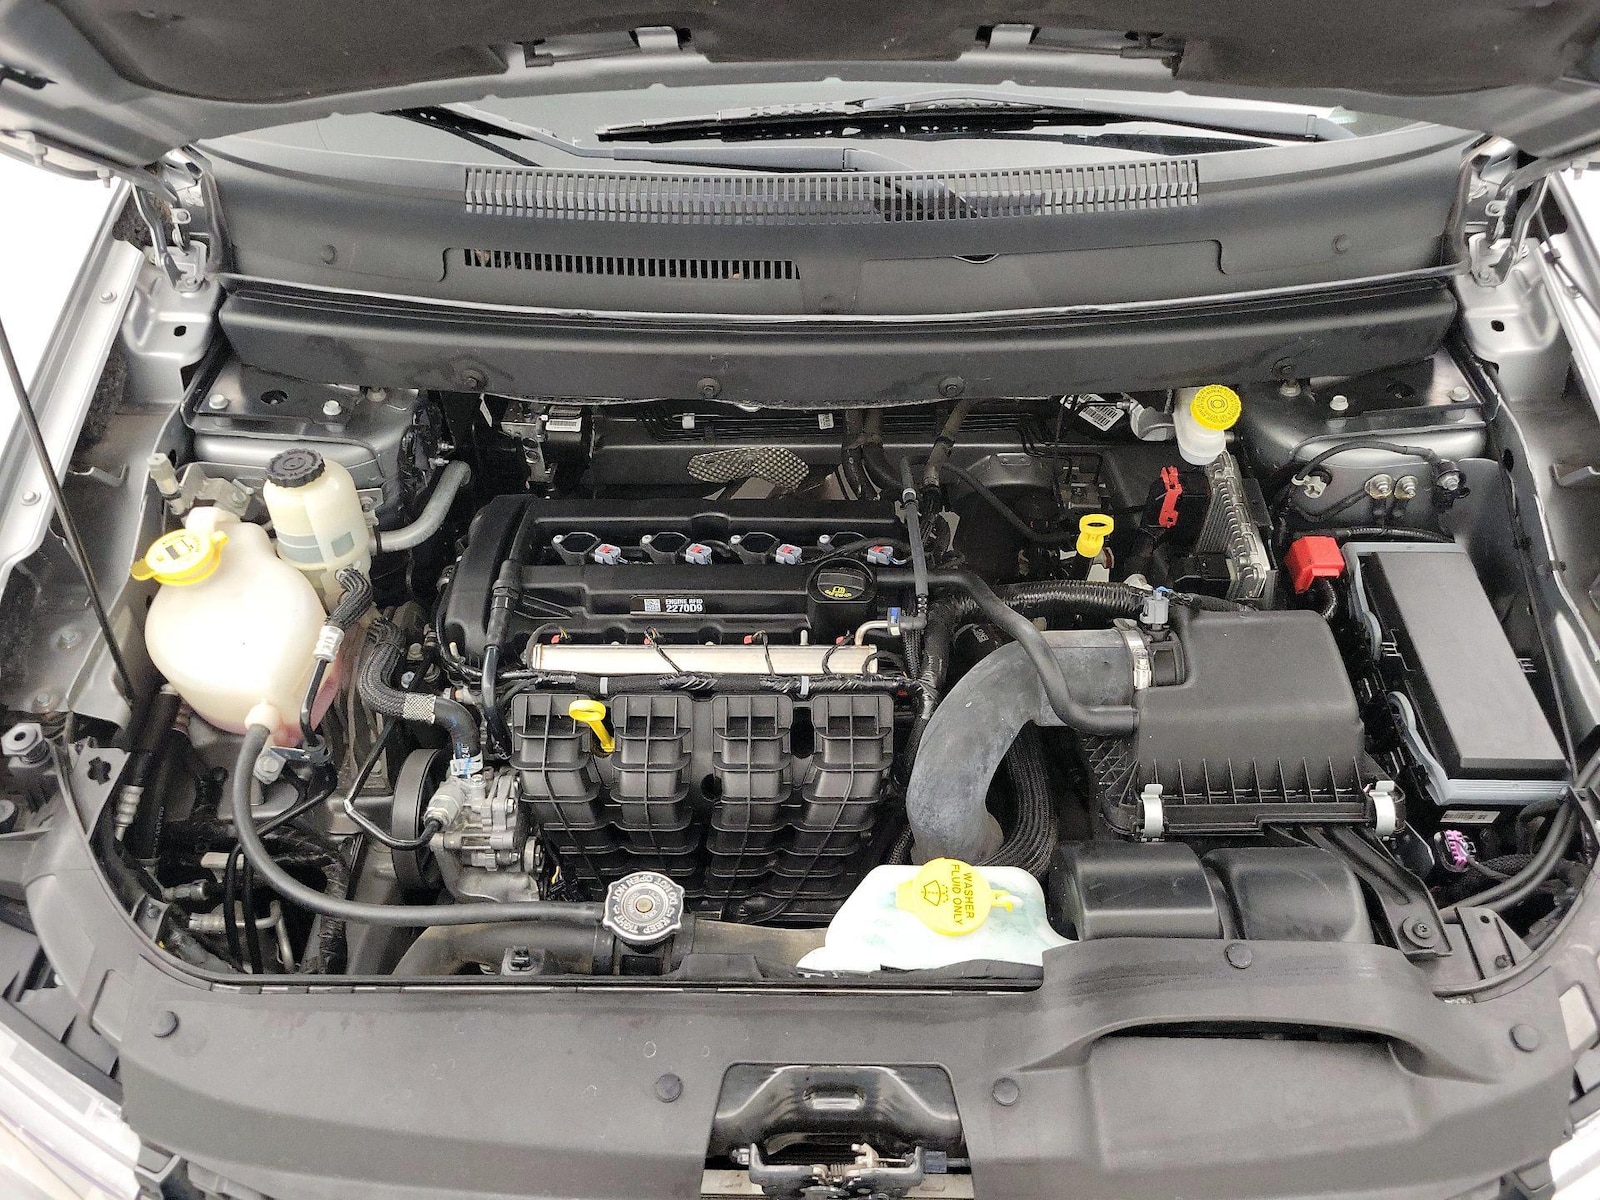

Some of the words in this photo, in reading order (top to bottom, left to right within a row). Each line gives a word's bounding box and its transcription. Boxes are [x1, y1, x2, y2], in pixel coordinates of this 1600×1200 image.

[666, 604, 703, 612] 2270D9
[626, 876, 653, 886] OPEN
[654, 878, 673, 892] NOT
[951, 865, 961, 894] FLUID
[612, 884, 628, 902] HOT
[668, 892, 678, 905] DO
[964, 872, 974, 918] WASHER
[952, 898, 963, 925] ONLY
[614, 916, 638, 934] TIGHT
[644, 918, 670, 934] KEEP
